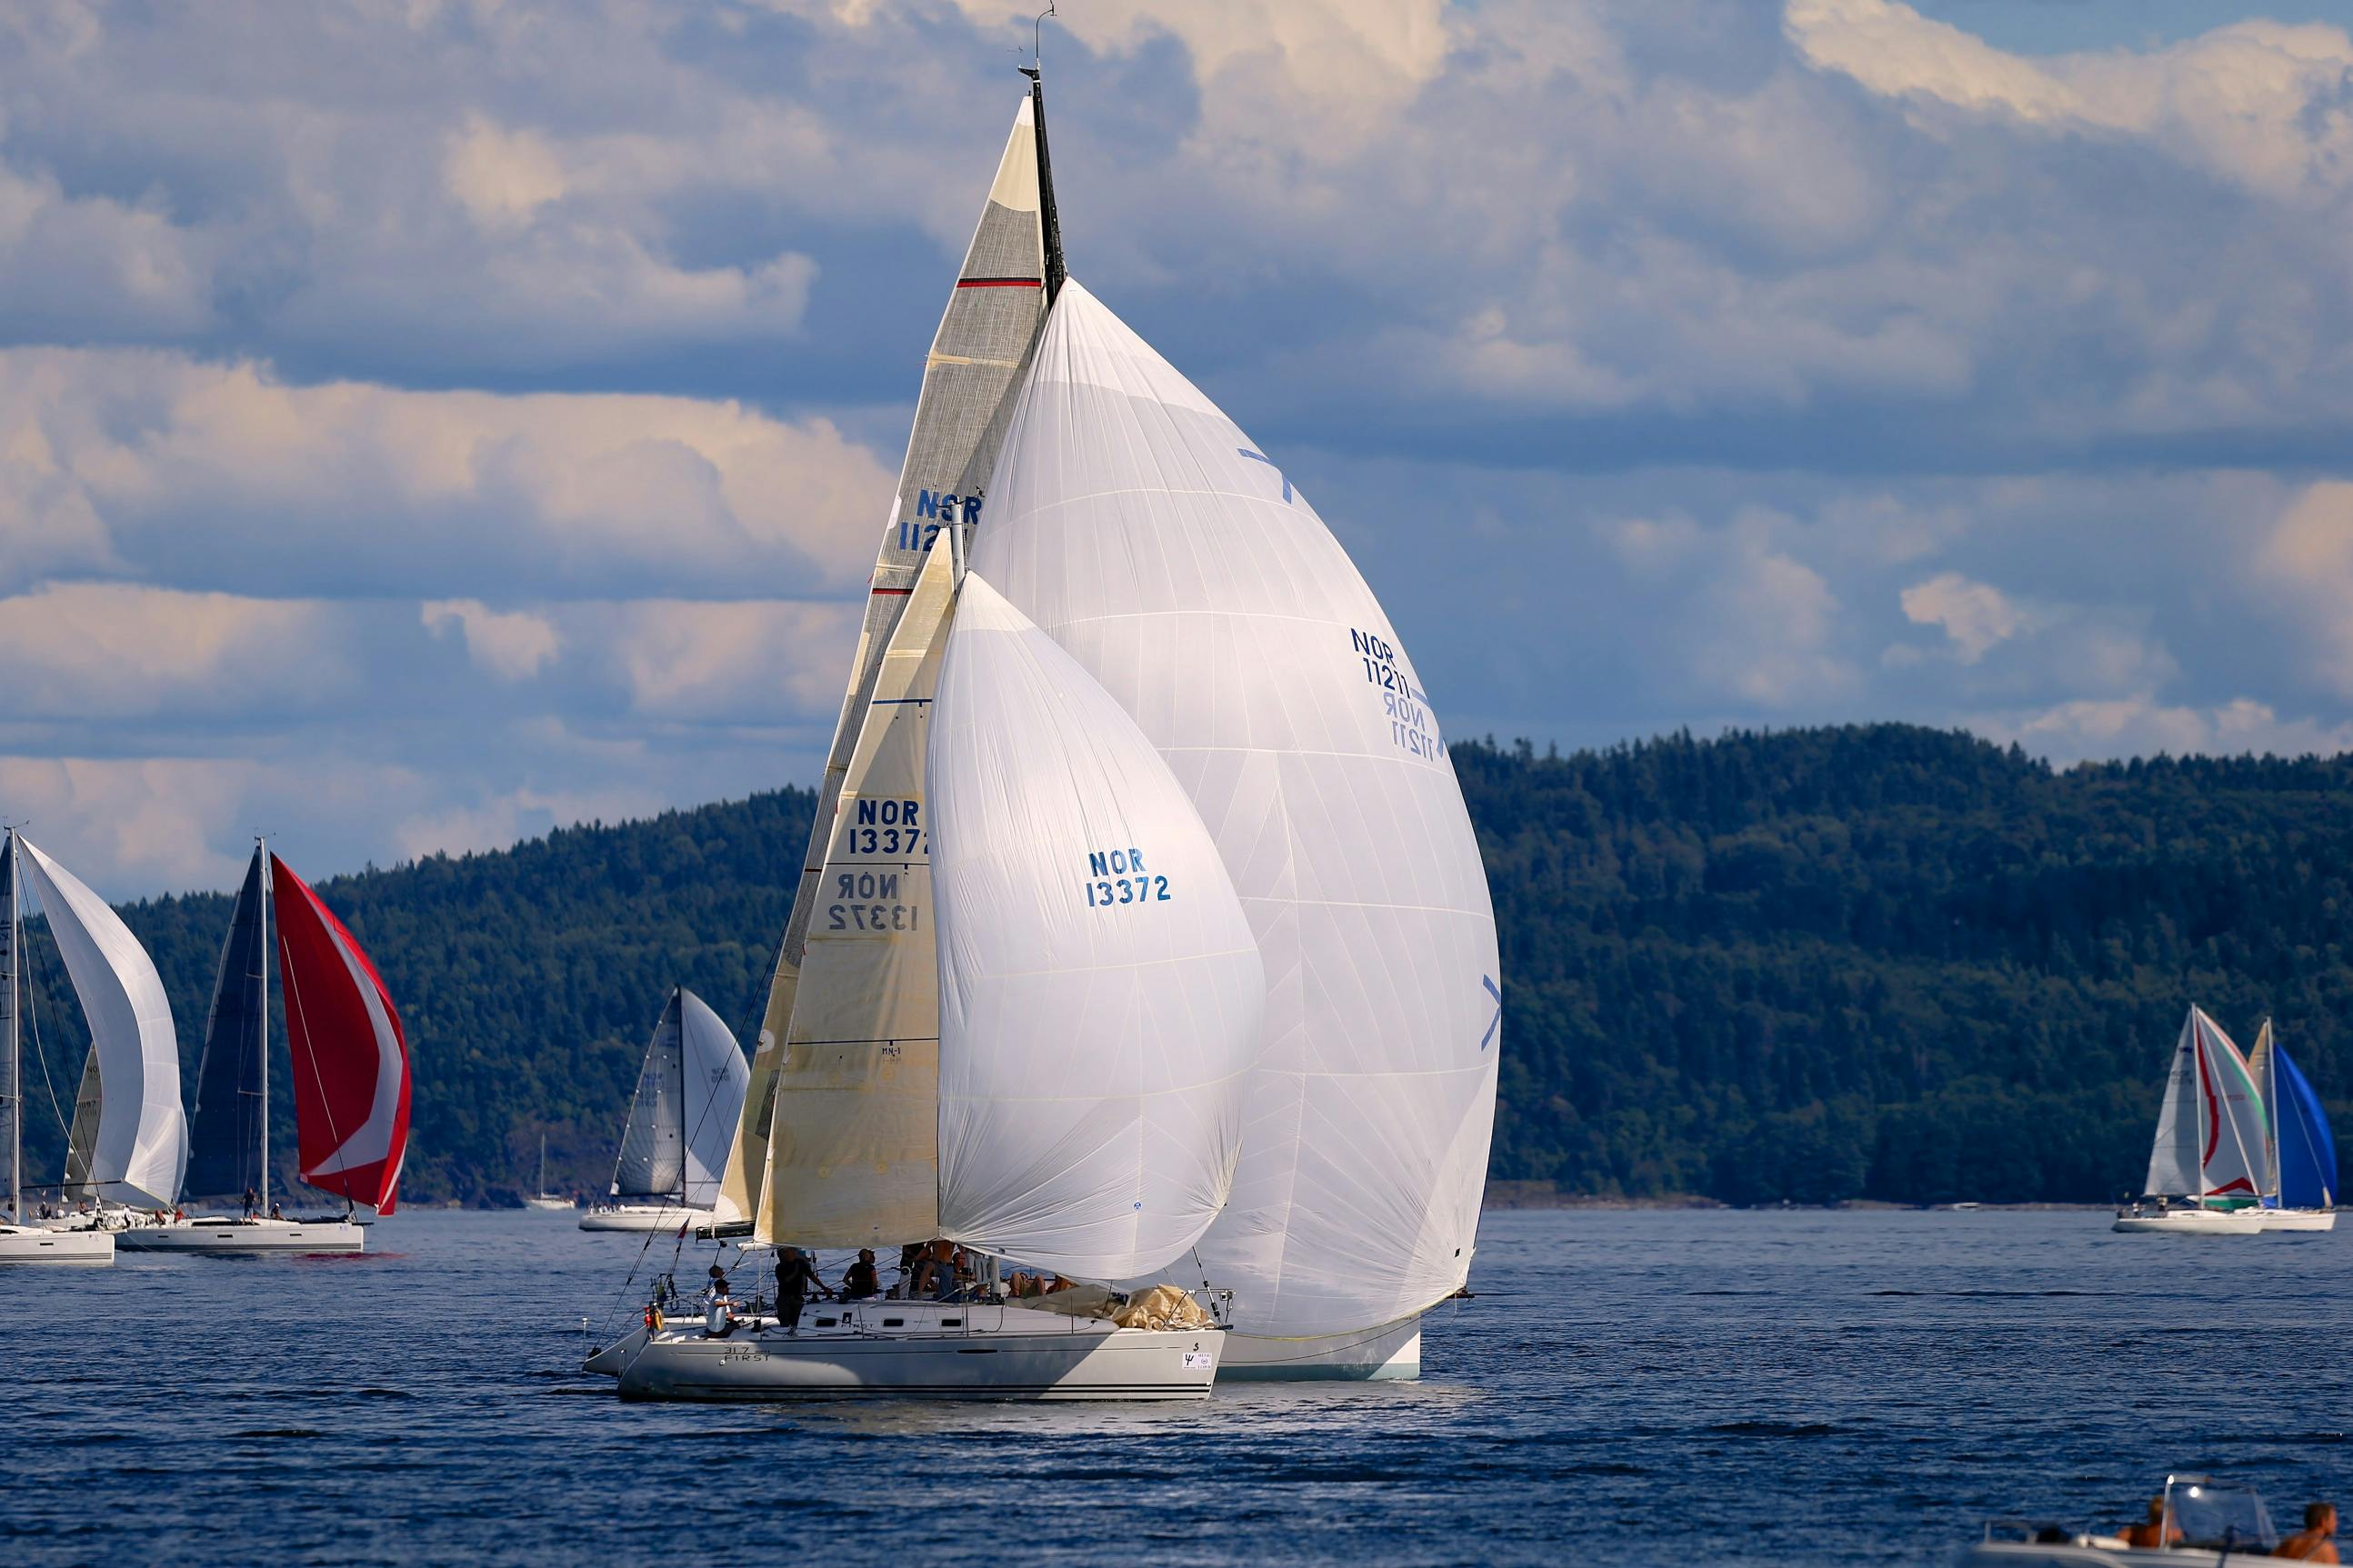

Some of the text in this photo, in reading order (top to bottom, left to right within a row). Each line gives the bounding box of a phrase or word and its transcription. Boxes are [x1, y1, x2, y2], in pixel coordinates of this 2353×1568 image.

[916, 489, 982, 524] NOR
[899, 522, 968, 556] 112
[1350, 628, 1396, 667] NOR
[1363, 657, 1410, 699] 11211
[858, 800, 919, 826] NOR
[1088, 848, 1146, 877] NOR
[1086, 875, 1171, 907] 13372
[882, 1046, 901, 1054] MN-1
